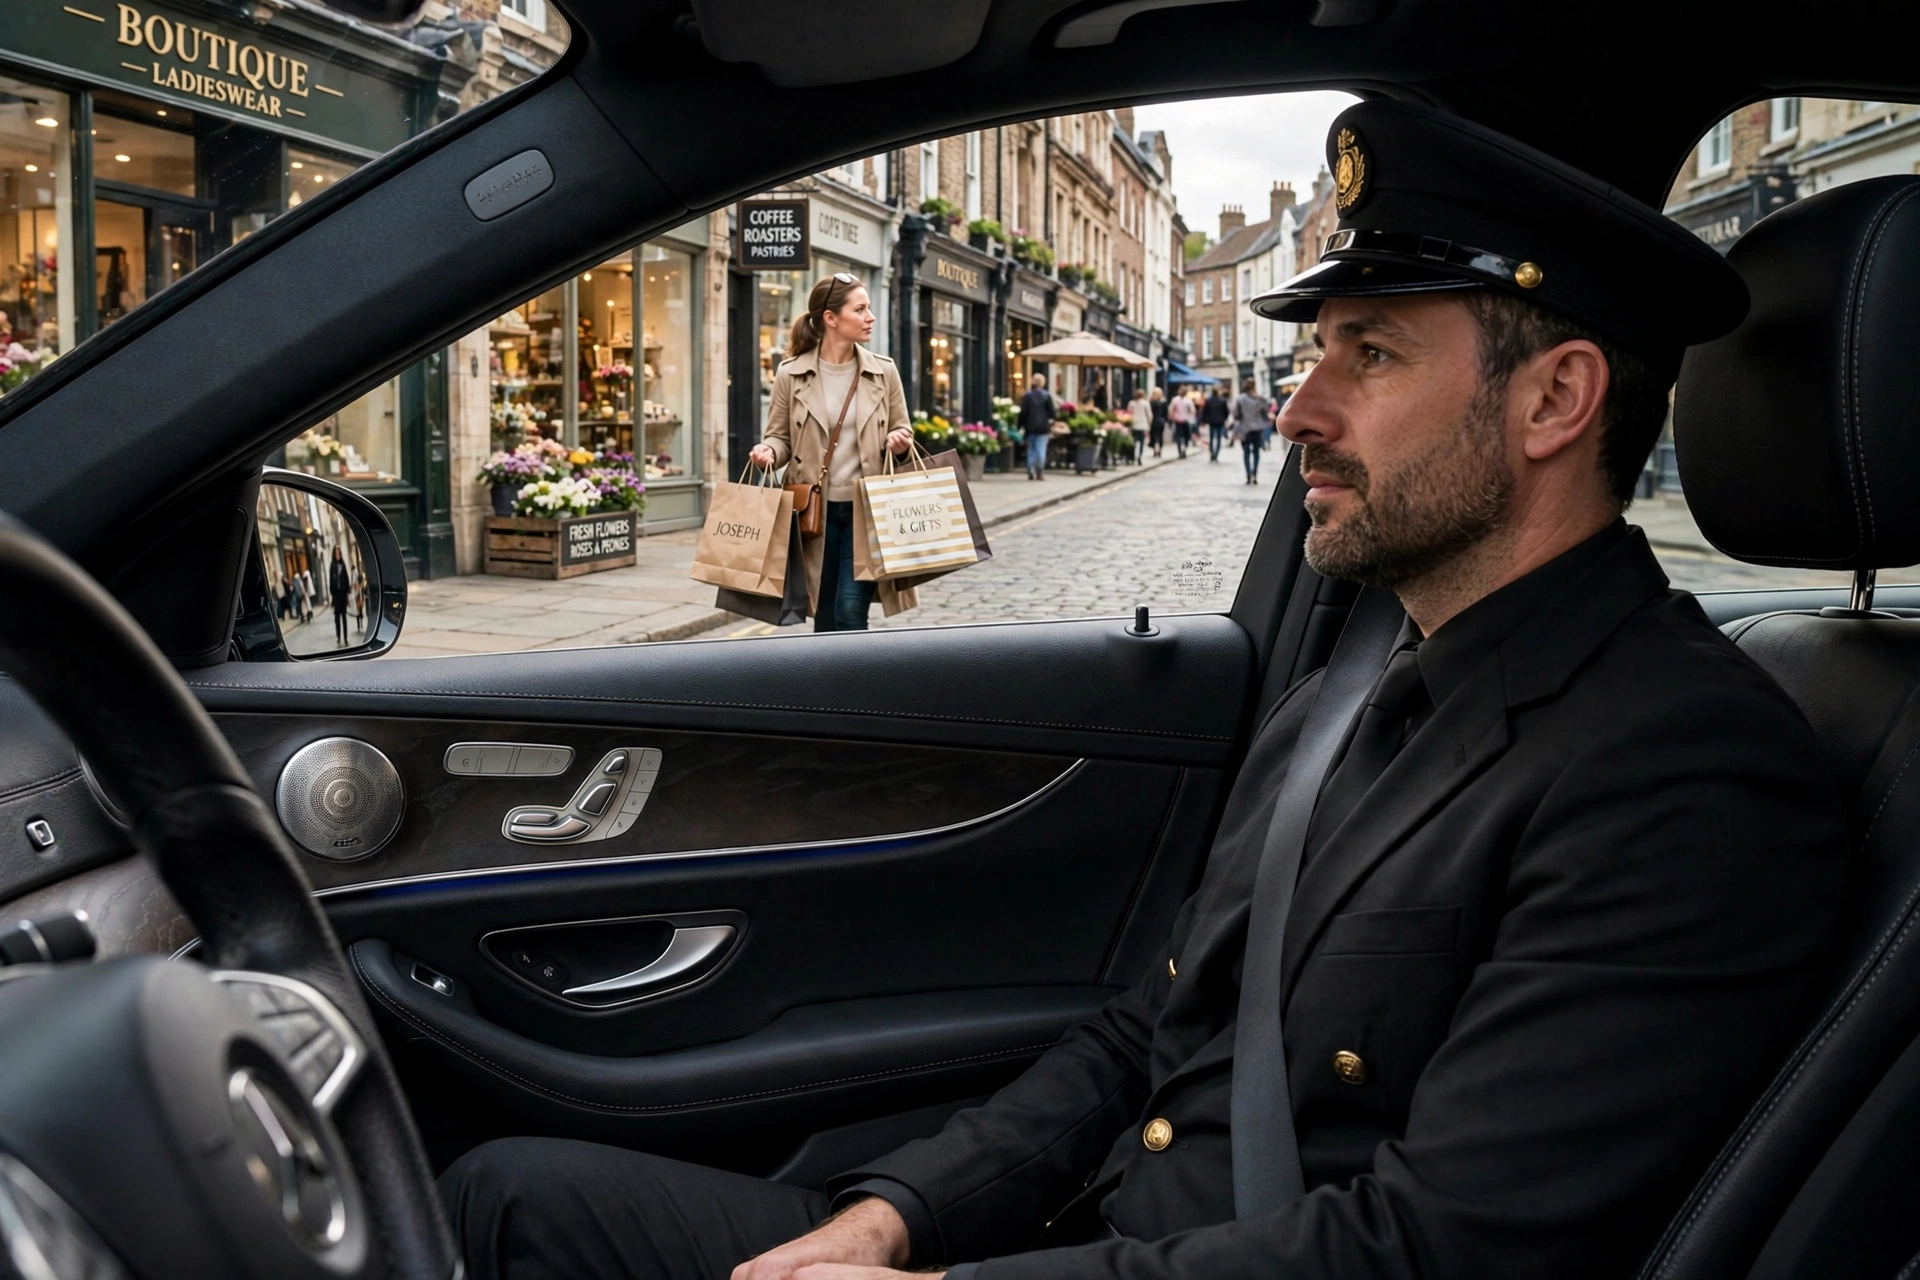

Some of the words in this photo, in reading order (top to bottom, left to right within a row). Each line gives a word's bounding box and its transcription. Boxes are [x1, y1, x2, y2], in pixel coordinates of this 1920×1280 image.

[116, 3, 309, 98] BOUTIQUE
[152, 62, 283, 118] LADIESWEAR
[749, 210, 795, 225] COFFEE
[743, 227, 802, 243] ROASTERS
[750, 245, 796, 258] PASTRIES
[936, 258, 978, 289] BOUTIQUE
[892, 502, 943, 519] FLOWERS
[569, 522, 595, 541] FRESH
[595, 519, 630, 538] FLOWERS
[712, 521, 761, 541] JOSEPH
[899, 523, 907, 535] &
[909, 518, 942, 534] GIFTS
